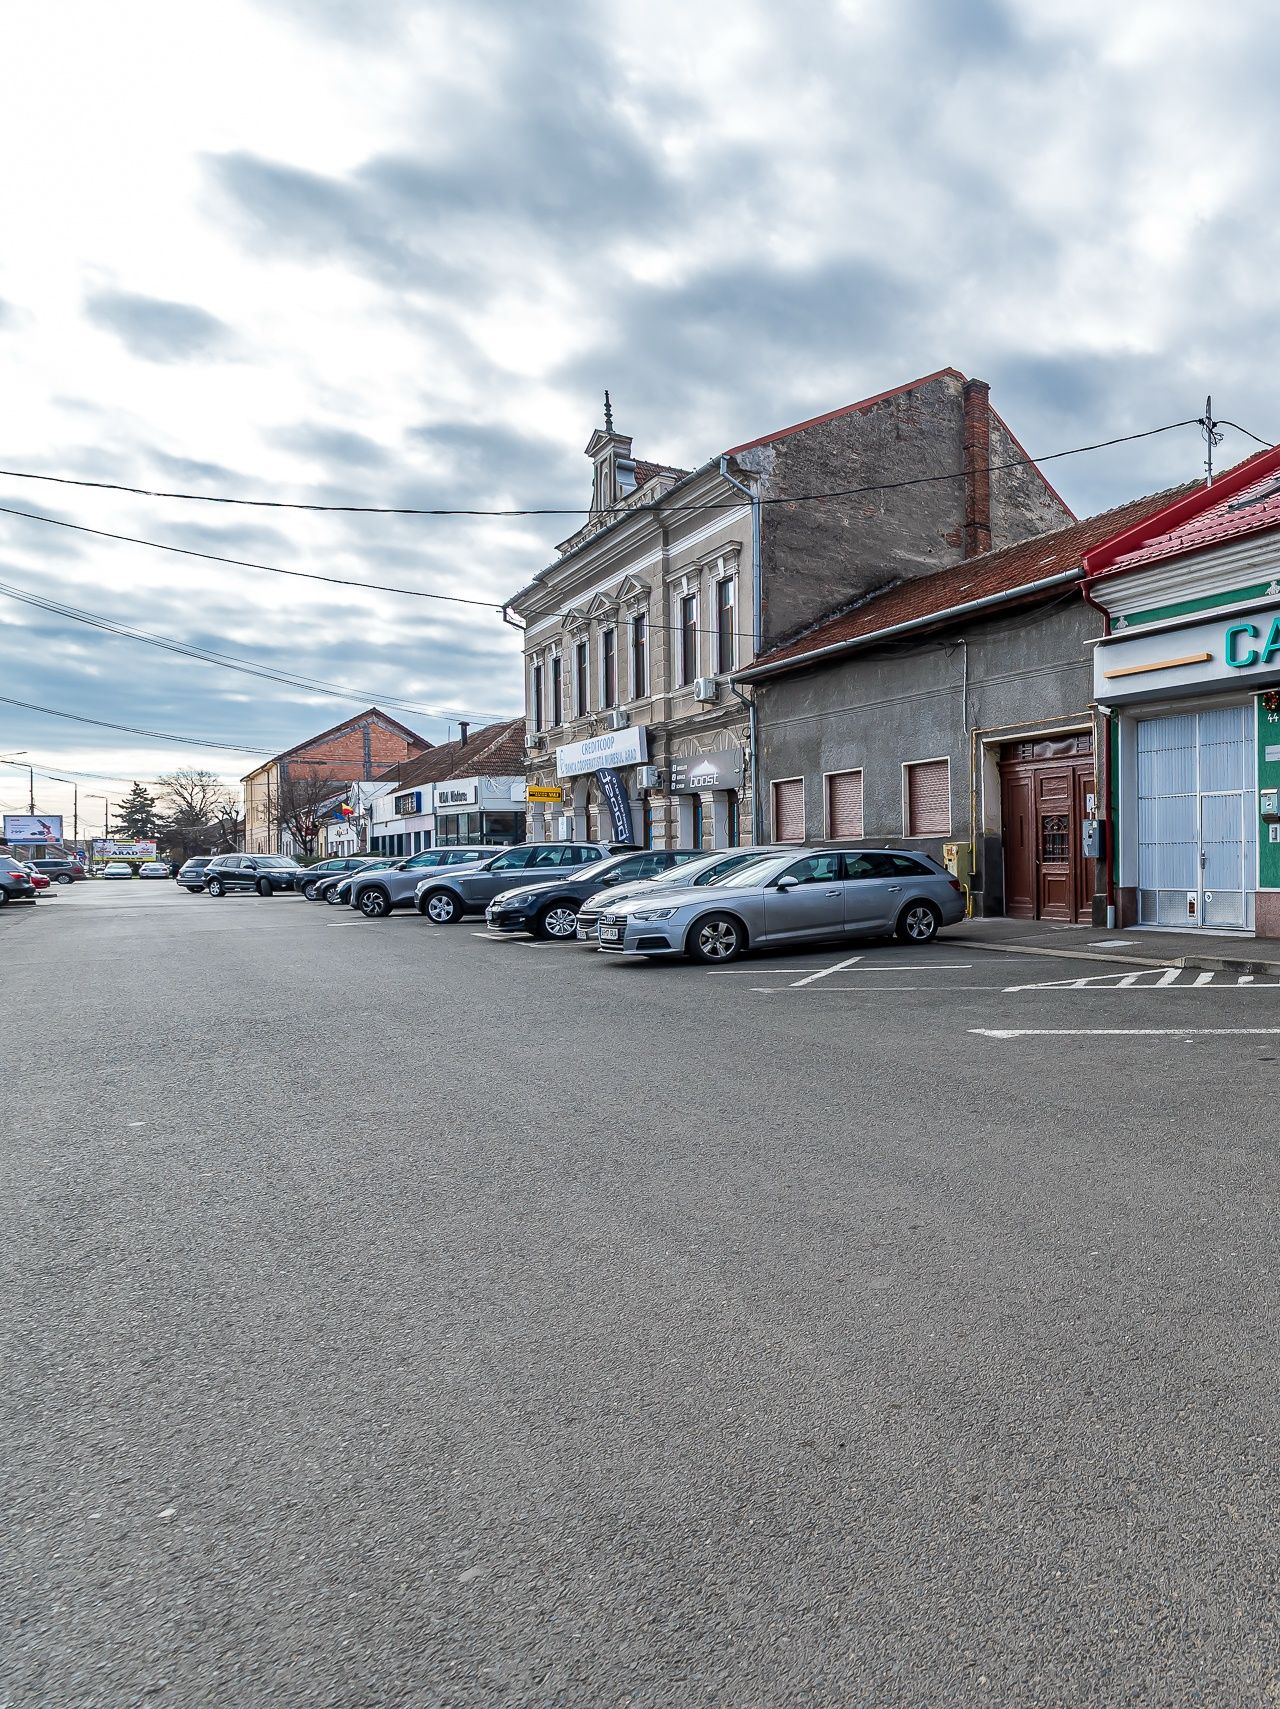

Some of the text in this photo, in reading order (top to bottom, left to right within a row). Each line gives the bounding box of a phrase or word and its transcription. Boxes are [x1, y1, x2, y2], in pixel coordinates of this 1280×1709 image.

[1267, 713, 1279, 723] 44
[581, 736, 615, 756] CREDITCOOP
[690, 771, 719, 788] boost
